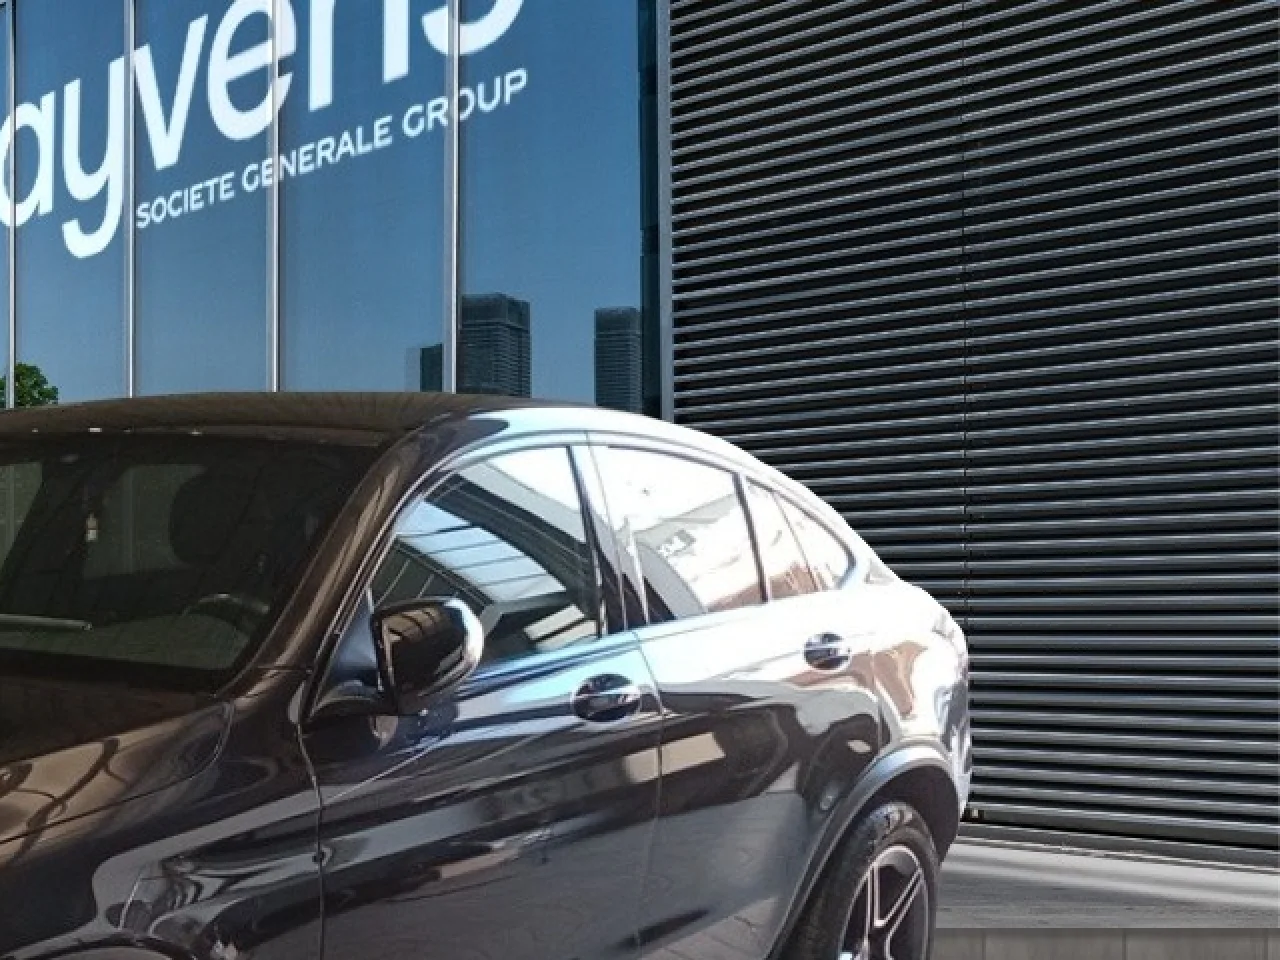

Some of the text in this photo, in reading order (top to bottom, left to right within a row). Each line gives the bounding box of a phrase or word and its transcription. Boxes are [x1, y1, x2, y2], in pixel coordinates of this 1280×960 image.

[136, 67, 528, 229] SOCIETE GENERALE GROUP
